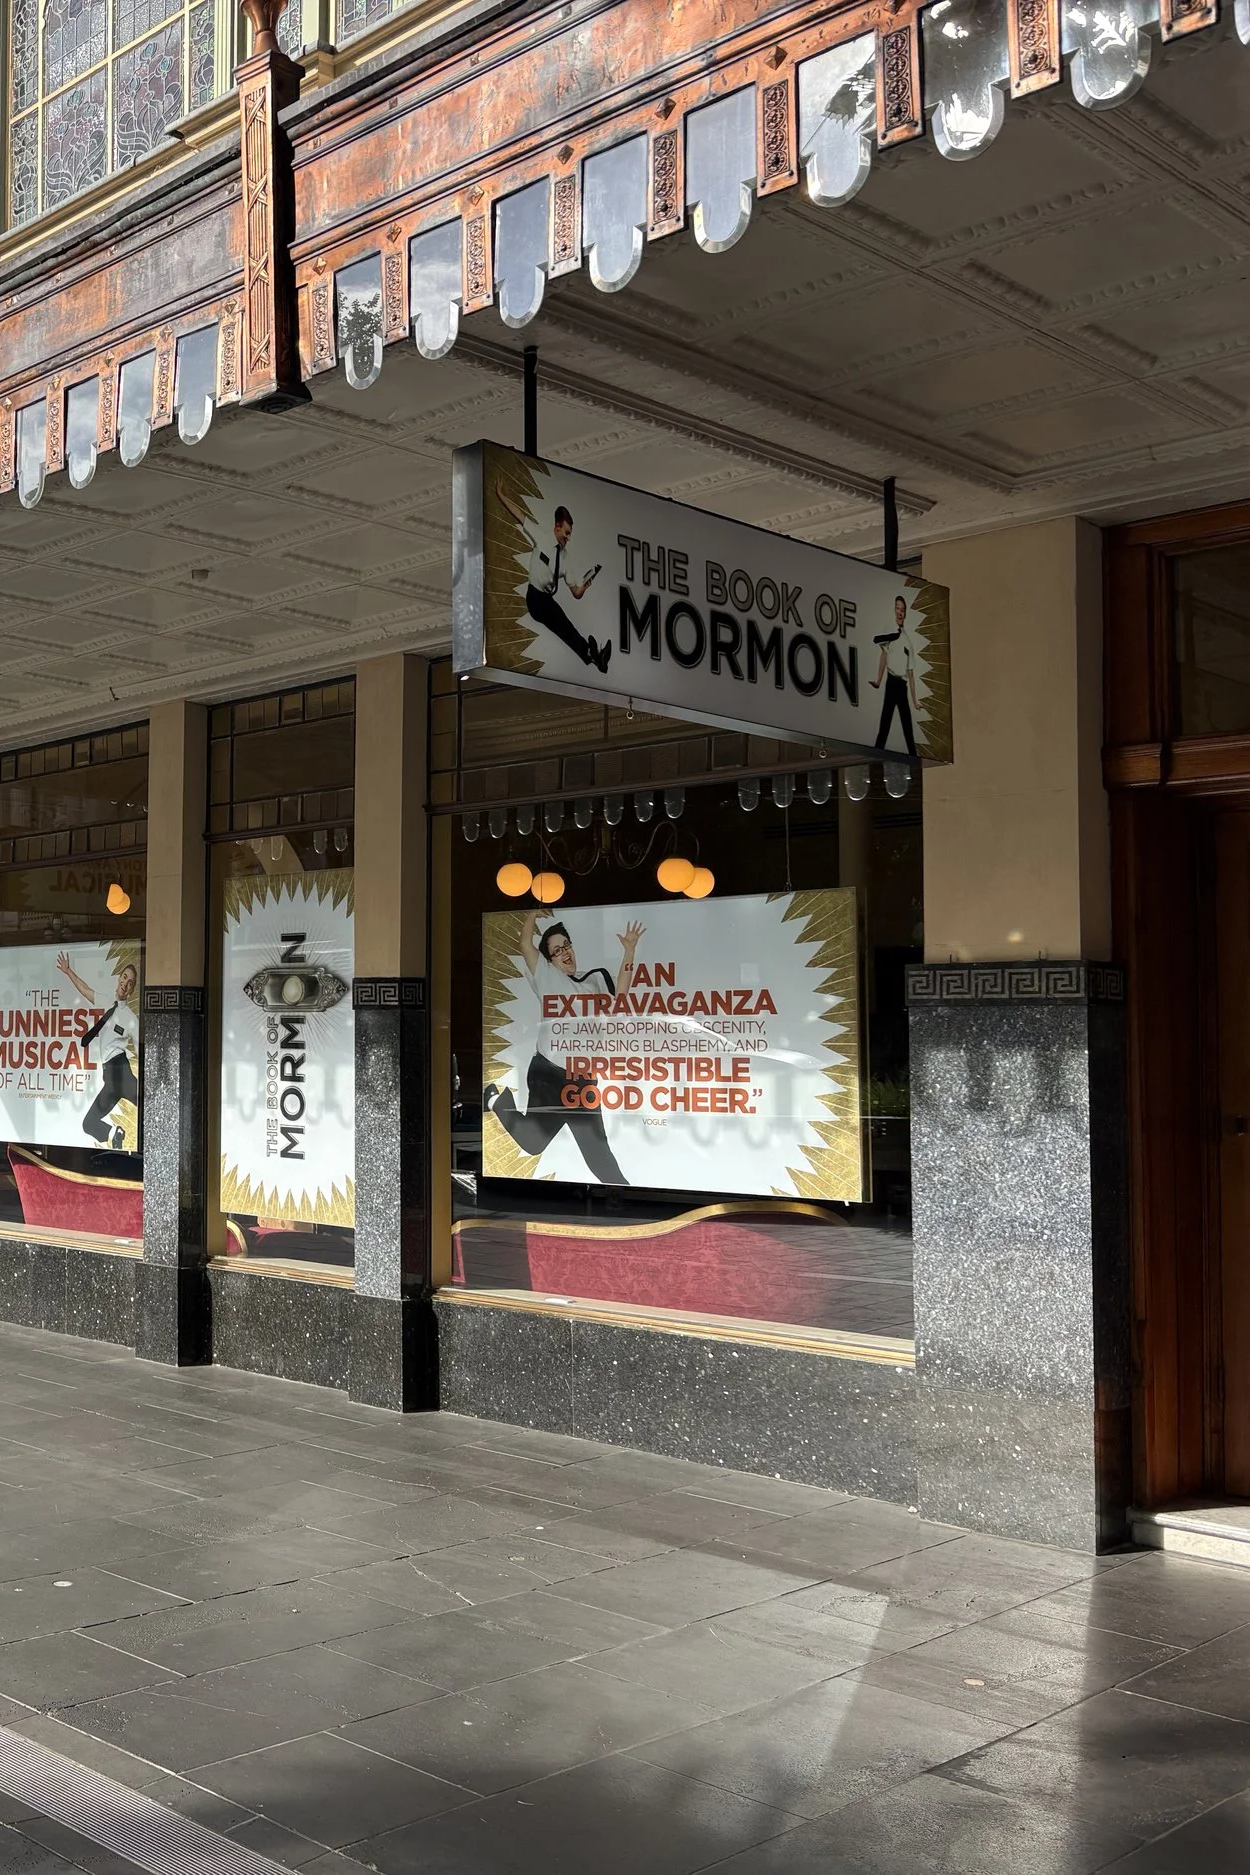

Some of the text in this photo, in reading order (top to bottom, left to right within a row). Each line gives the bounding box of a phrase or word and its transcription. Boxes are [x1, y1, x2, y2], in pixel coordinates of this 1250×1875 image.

[617, 534, 856, 639] THE BOOK OF
[618, 585, 859, 707] MORMON
[542, 989, 777, 1018] EXTRAVAGANZA
[551, 1022, 570, 1035] OF
[572, 1021, 678, 1036] JAW-DROPPING
[550, 1039, 768, 1054] HAIR-RAISING BLASPHEMY, AND
[17, 1073, 45, 1091] ALL
[565, 1056, 751, 1083] IRRESISTIBLE
[266, 1016, 279, 1158] THE BOOK OF
[560, 1086, 644, 1111] GOOD
[642, 1118, 668, 1127] VOGUE
